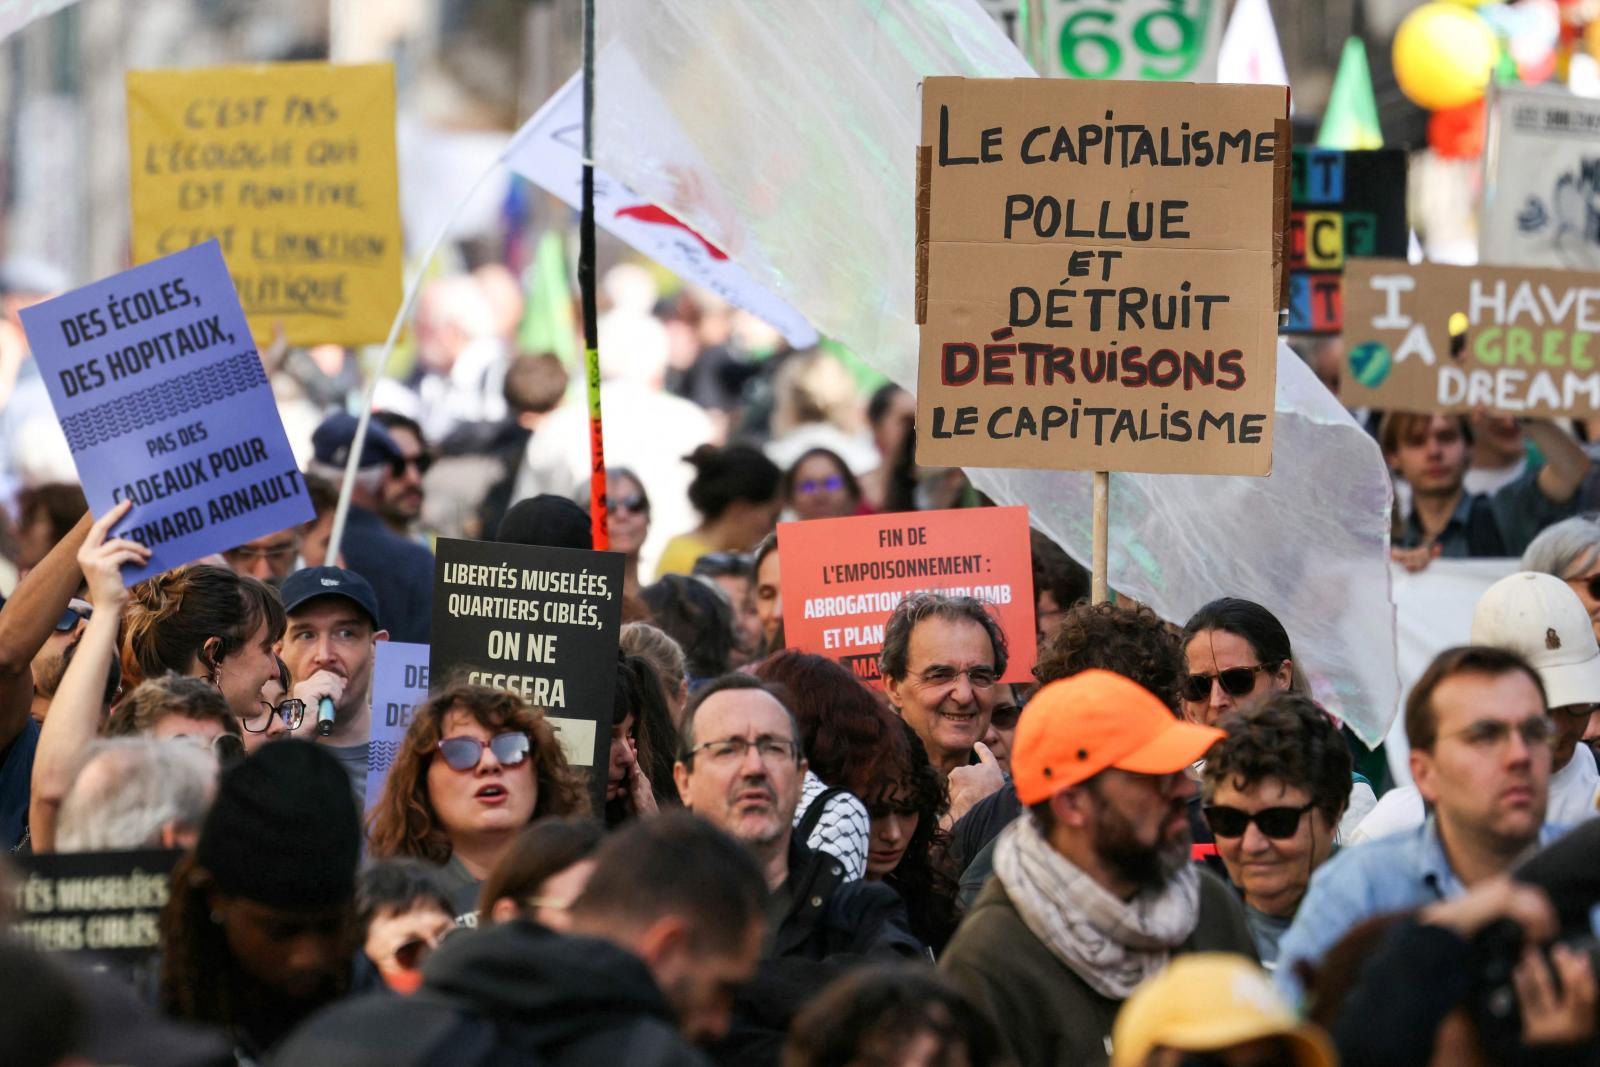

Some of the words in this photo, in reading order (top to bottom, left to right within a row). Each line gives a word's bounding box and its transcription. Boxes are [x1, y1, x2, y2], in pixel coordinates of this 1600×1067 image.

[1004, 194, 1190, 241] POLLUE
[1068, 251, 1122, 281] ET
[60, 307, 107, 347] DES
[107, 278, 200, 329] ÉCOLES,
[1370, 275, 1415, 329] I
[1469, 279, 1600, 332] HAVE
[59, 357, 105, 398] DES
[106, 315, 235, 381] HOPITAUX,
[1394, 324, 1435, 366] A
[1474, 326, 1594, 369] GREE
[1438, 365, 1600, 410] DREAM
[146, 434, 177, 459] PAS
[180, 421, 208, 448] DES
[932, 406, 978, 439] LE
[112, 460, 210, 507] CADEAUX
[208, 436, 269, 475] POUR
[207, 470, 301, 525] ARNAULT
[879, 529, 903, 548] FIN
[908, 527, 927, 546] DE
[443, 561, 517, 589] LIBERTÉS
[521, 569, 612, 600] MUSELÉES,
[823, 555, 982, 585] L'EMPOISONNEMENT
[448, 593, 539, 622] QUARTIERS
[543, 601, 603, 630] CIBLÉS,
[804, 591, 901, 620] ABROGATION
[487, 630, 521, 661] ON
[526, 634, 558, 664] NE
[823, 629, 841, 649] ET
[844, 625, 884, 647] PLAN
[404, 664, 429, 689] DE
[852, 656, 881, 678] MA
[386, 702, 417, 727] DE
